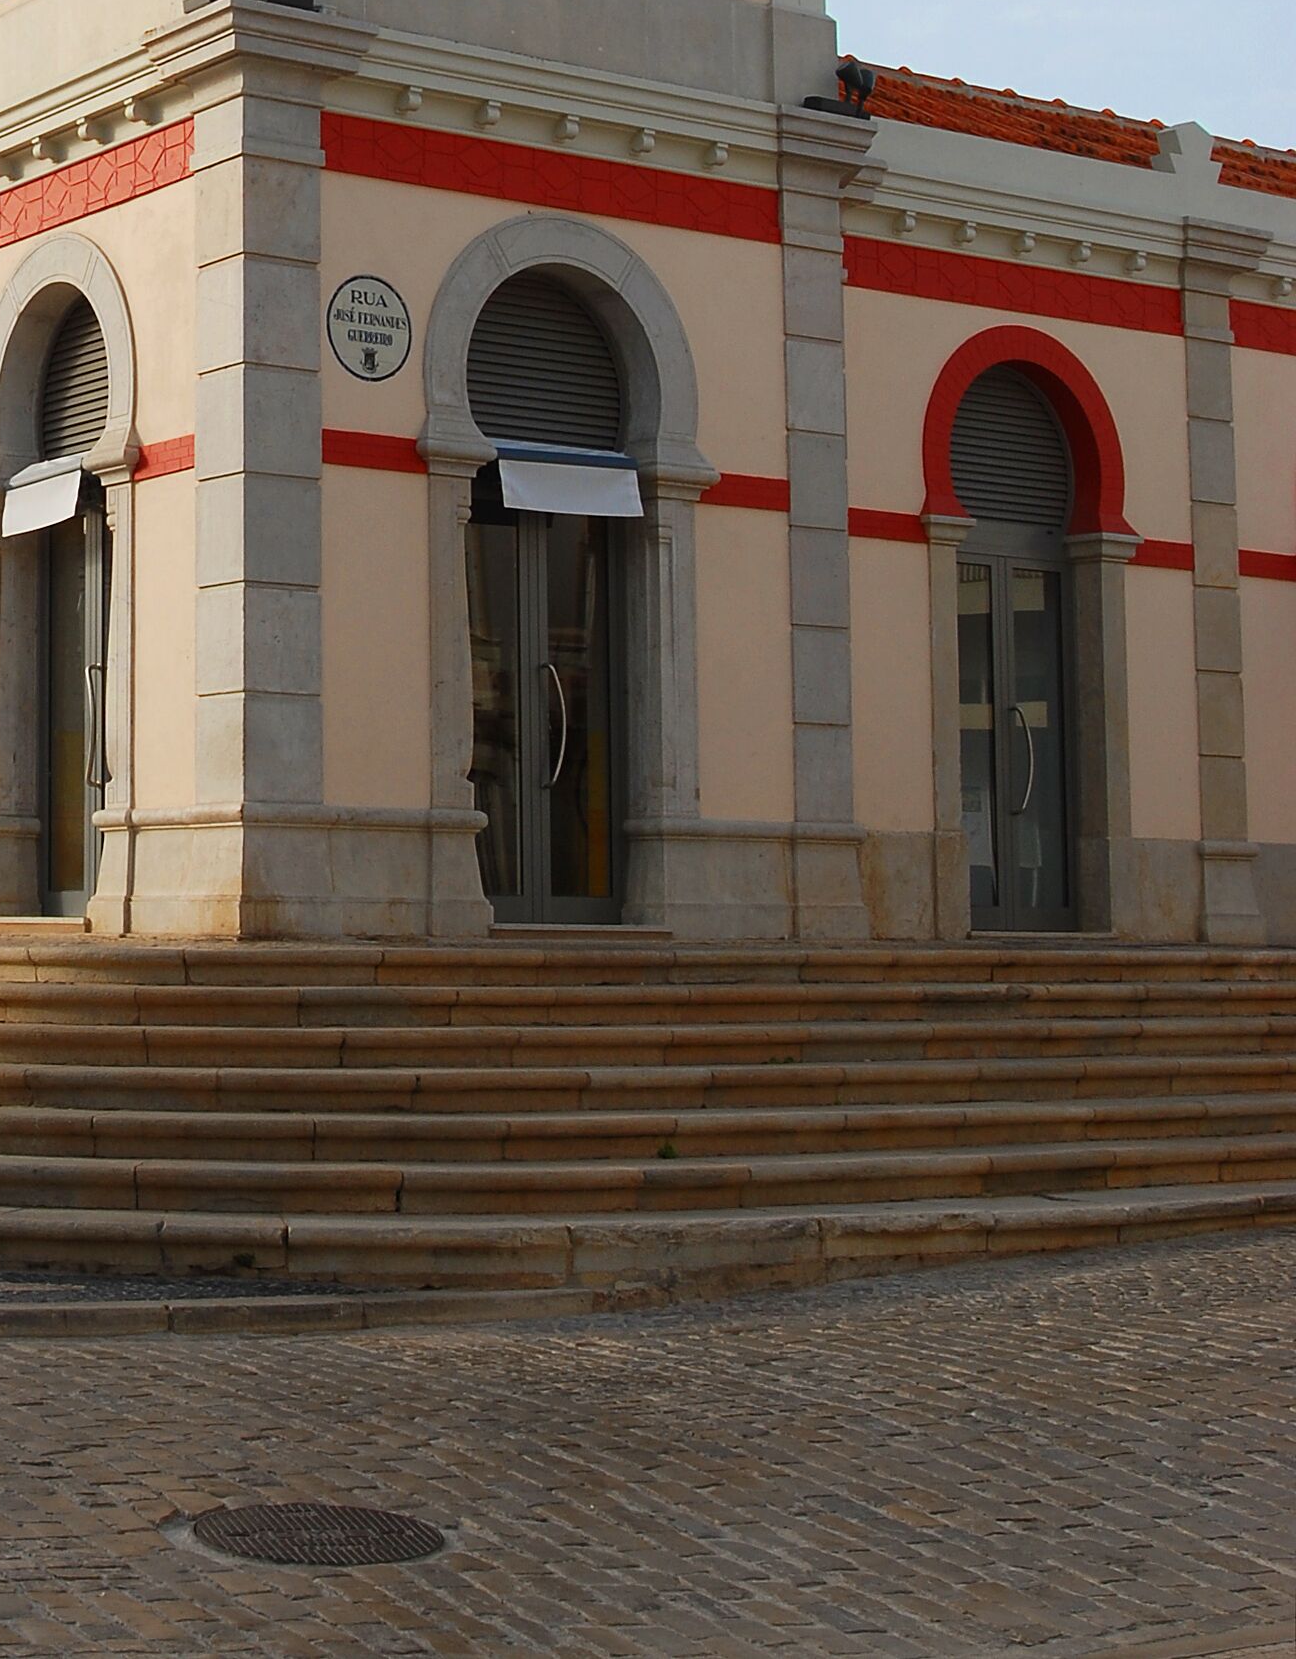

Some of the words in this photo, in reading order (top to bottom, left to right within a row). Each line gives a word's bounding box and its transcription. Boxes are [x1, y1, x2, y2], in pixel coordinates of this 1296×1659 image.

[351, 290, 388, 308] RUA
[333, 307, 356, 323] JOSÉ
[358, 312, 407, 330] FERNANDES
[348, 329, 393, 347] GUERREIRO
